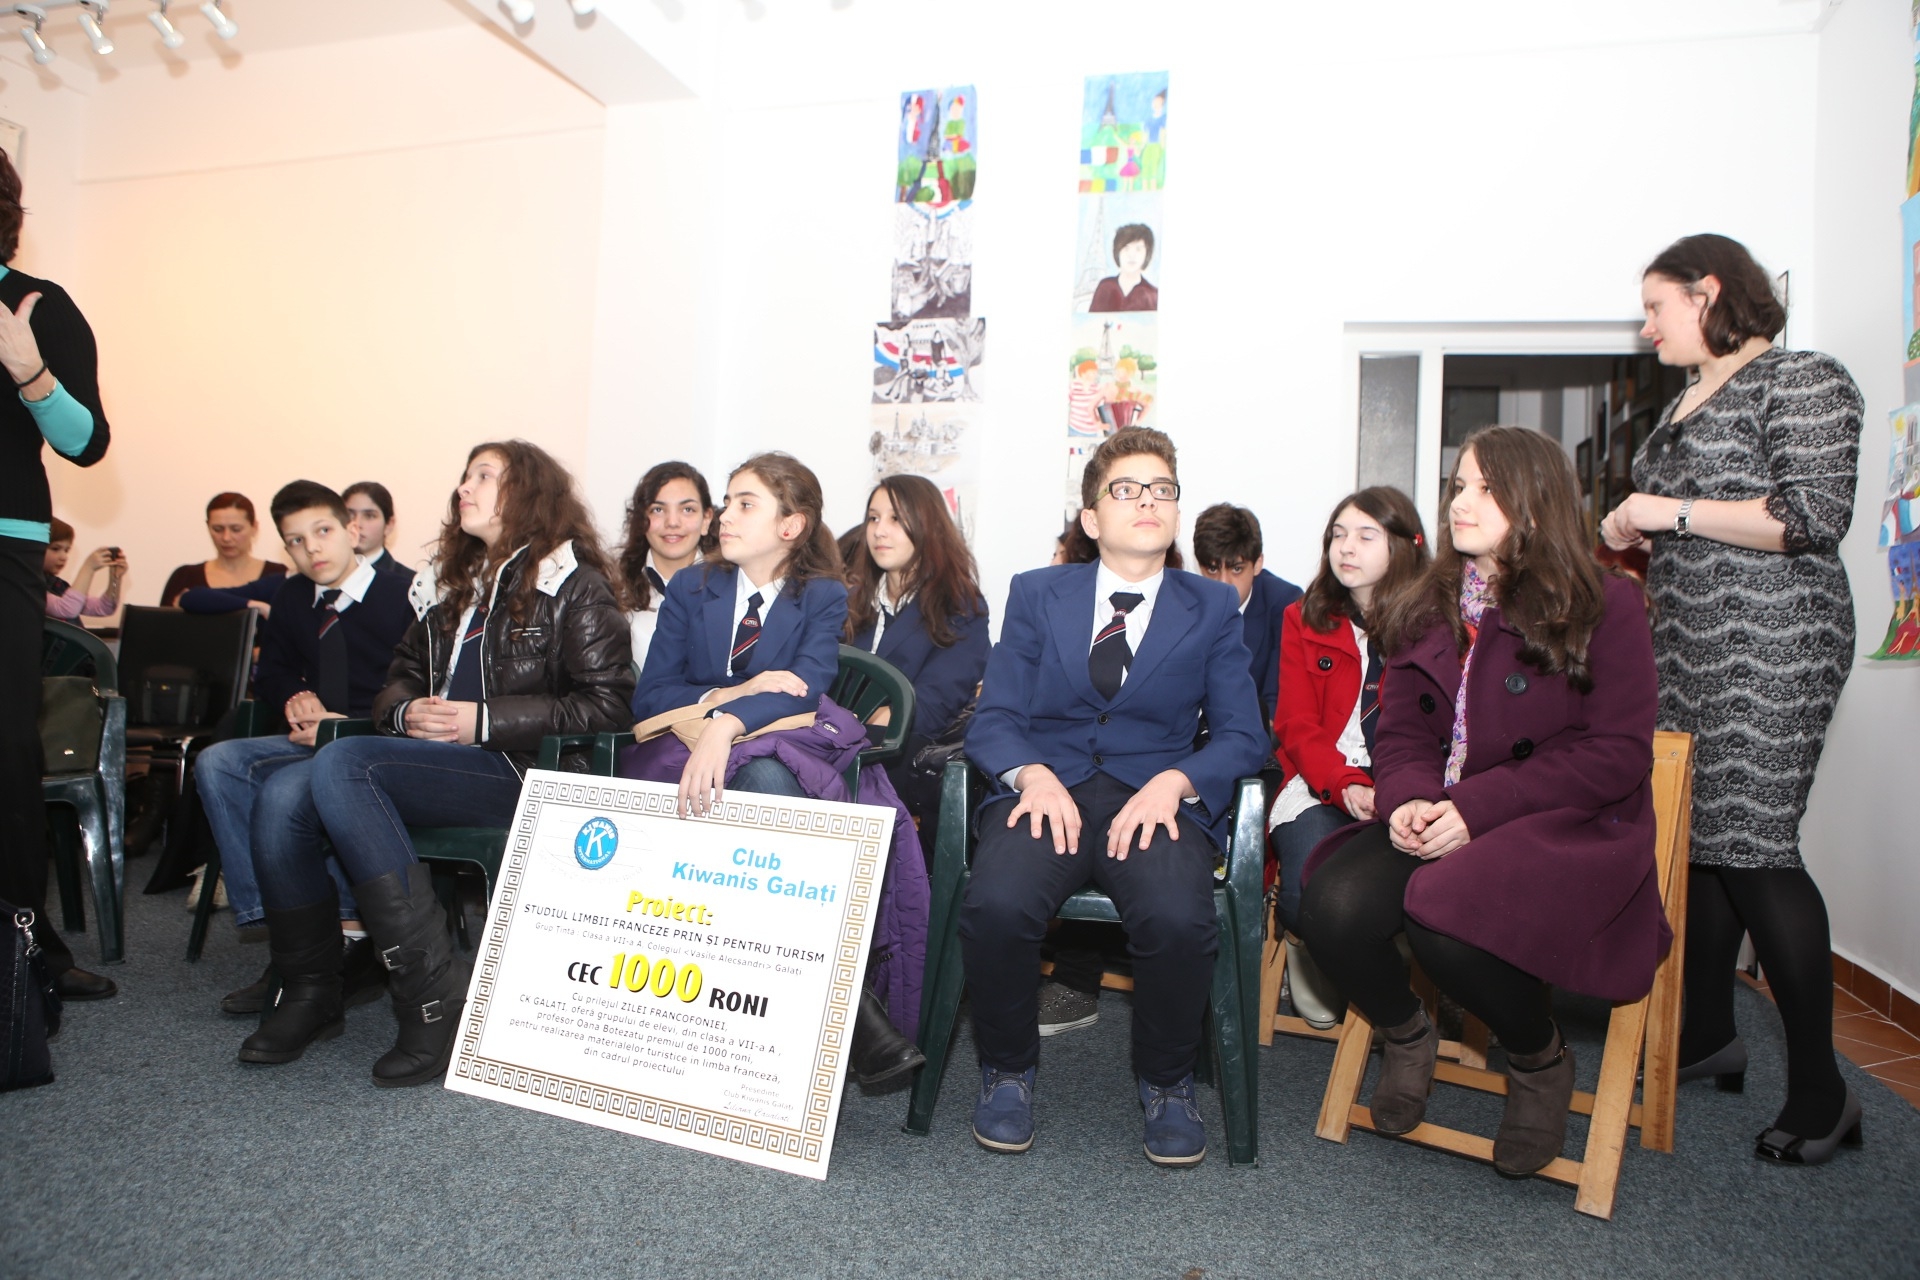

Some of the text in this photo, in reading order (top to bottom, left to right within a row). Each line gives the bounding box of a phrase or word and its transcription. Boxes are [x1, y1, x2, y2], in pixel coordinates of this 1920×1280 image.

[581, 820, 616, 839] KIWANIS
[577, 846, 612, 865] INTERNATIONAL
[732, 847, 781, 871] Club
[672, 861, 759, 891] Kiwanis
[767, 875, 837, 907] Galați
[626, 889, 714, 926] Proiect:
[524, 903, 569, 920] STUDIUL
[572, 912, 610, 927] LIMBII
[612, 919, 670, 937] FRANCEZE
[673, 929, 702, 943] PRIN
[722, 937, 772, 954] PENTRU
[775, 945, 825, 963] TURISM
[535, 922, 554, 932] Grup
[582, 930, 603, 941] Clasa
[613, 936, 634, 946] VII-a
[647, 941, 682, 955] Colegiul
[567, 952, 769, 1018] CEC 1000 RONI
[519, 993, 531, 1004] CK
[597, 1011, 636, 1026] grupului
[639, 1019, 651, 1029] de
[681, 1028, 697, 1038] din
[700, 1032, 726, 1044] clasa
[738, 1038, 765, 1052] VII-a
[572, 992, 728, 1032] Cu prilejul ZILEI FRANCOFONIEI,
[509, 1018, 538, 1031] pentru
[540, 1025, 585, 1041] realizarea
[587, 1034, 645, 1054] materialelor
[647, 1047, 687, 1064] turistice
[702, 1058, 731, 1072] limba
[537, 1010, 575, 1026] profesor
[577, 1018, 600, 1031] Oana
[602, 1024, 644, 1040] Botezatu
[646, 1034, 684, 1049] premiul
[686, 1042, 699, 1052] de
[702, 1045, 728, 1058] 1000
[583, 1046, 685, 1076] din cadrul proiectului
[723, 1089, 740, 1099] Club
[741, 1093, 770, 1106] Kiwanis
